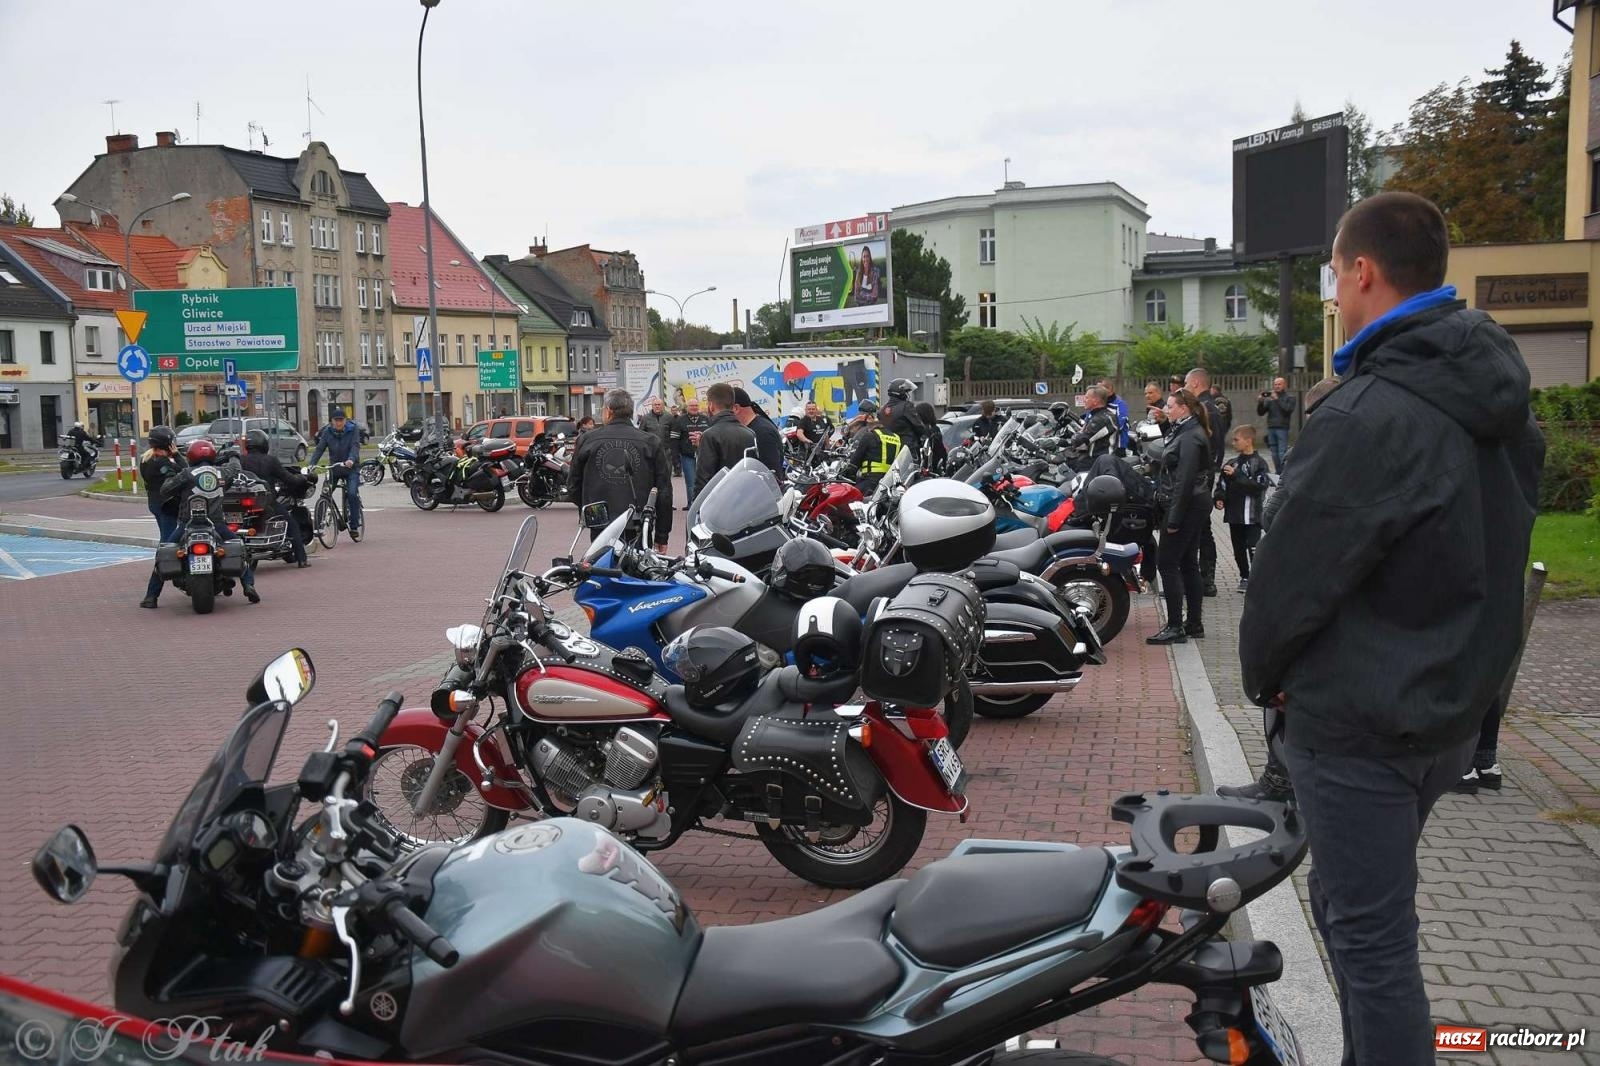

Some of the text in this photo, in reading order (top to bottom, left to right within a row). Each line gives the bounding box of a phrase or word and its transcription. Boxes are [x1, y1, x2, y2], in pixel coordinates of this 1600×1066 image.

[857, 219, 873, 233] min
[182, 294, 220, 306] Rybnik
[182, 308, 224, 319] Gliwice
[216, 322, 247, 333] Miejski
[188, 338, 282, 348] Starostwo Powiatowe
[162, 357, 220, 370] 45 Opole
[686, 361, 737, 380] PROXIMA
[760, 376, 768, 386] 50
